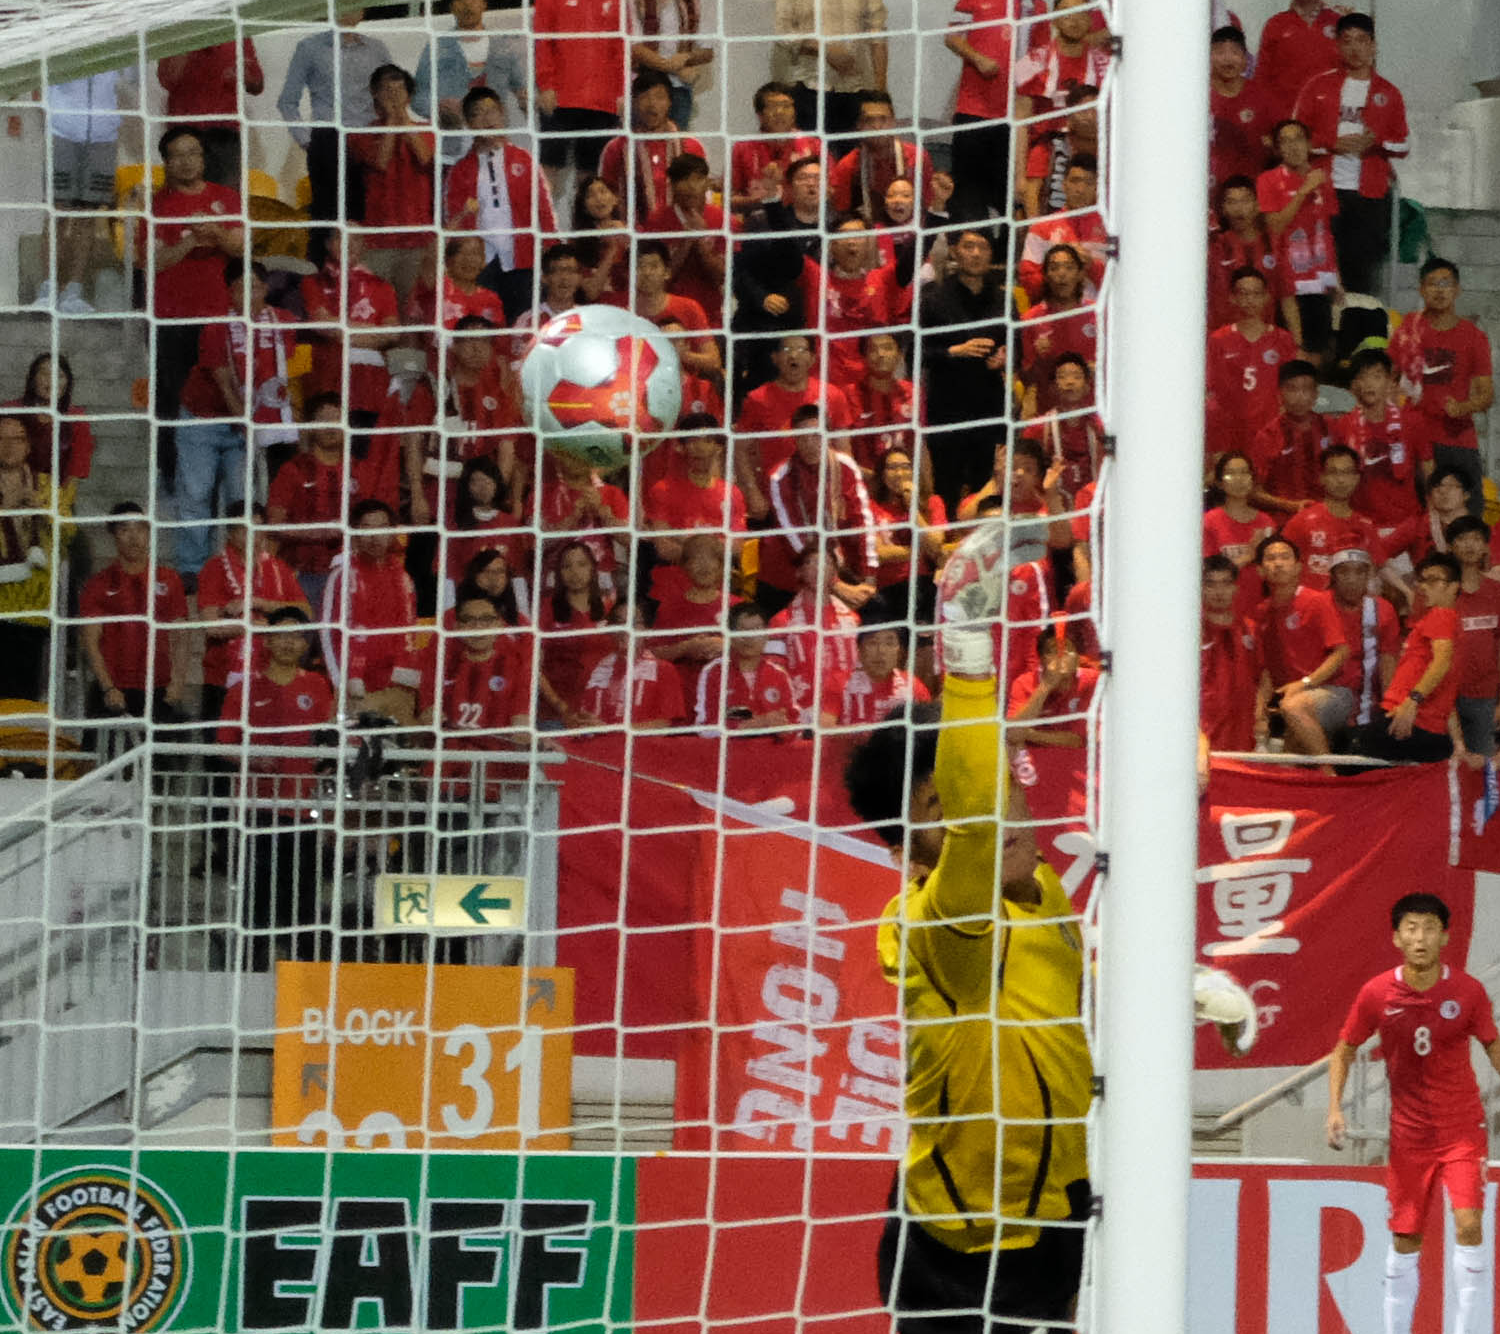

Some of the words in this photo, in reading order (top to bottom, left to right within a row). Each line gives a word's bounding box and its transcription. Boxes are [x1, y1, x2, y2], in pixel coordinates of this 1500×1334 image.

[1242, 366, 1257, 392] 5
[456, 702, 483, 729] 22
[299, 1008, 417, 1047] BLOCK
[1413, 1025, 1433, 1057] 8
[440, 1023, 542, 1139] 31
[241, 1195, 594, 1333] EAFF
